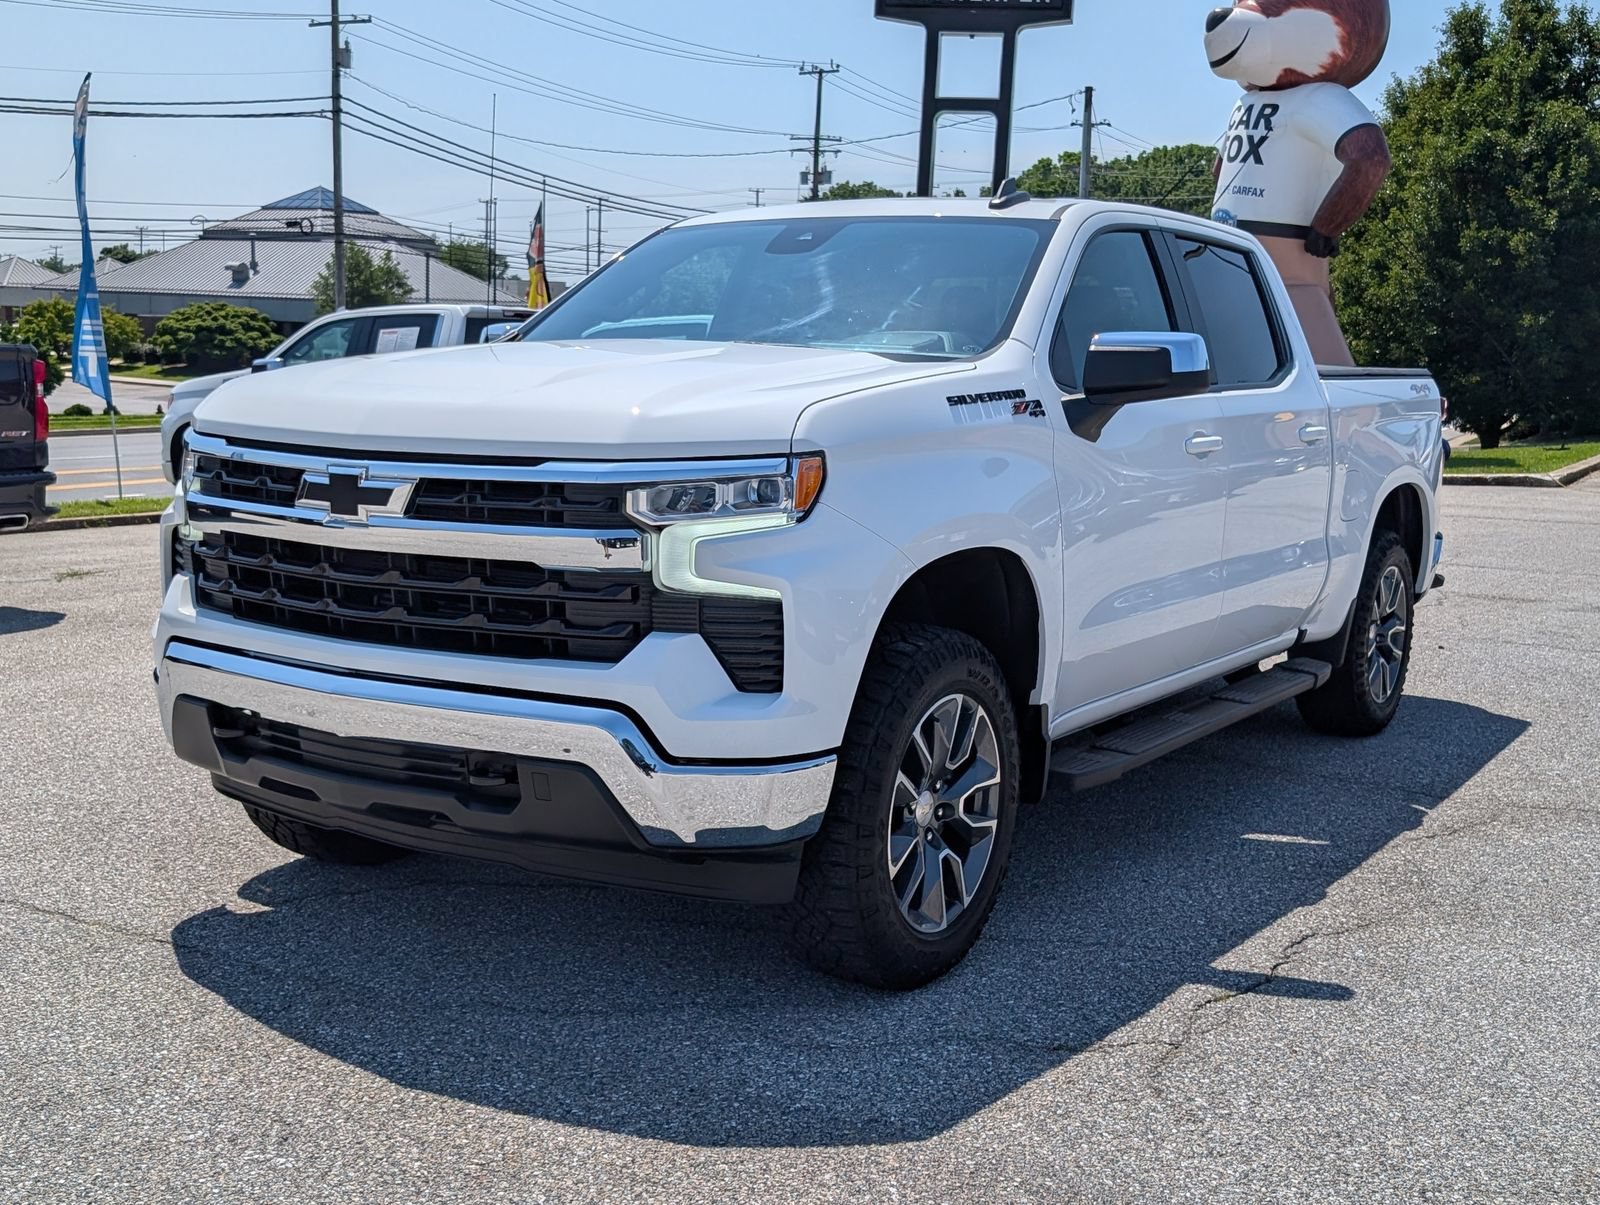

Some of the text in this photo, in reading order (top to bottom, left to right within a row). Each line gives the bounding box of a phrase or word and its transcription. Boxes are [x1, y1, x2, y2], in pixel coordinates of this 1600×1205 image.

[1228, 103, 1280, 132] CAR
[1231, 185, 1265, 198] CARFAX
[946, 389, 1026, 406] SILVERADO
